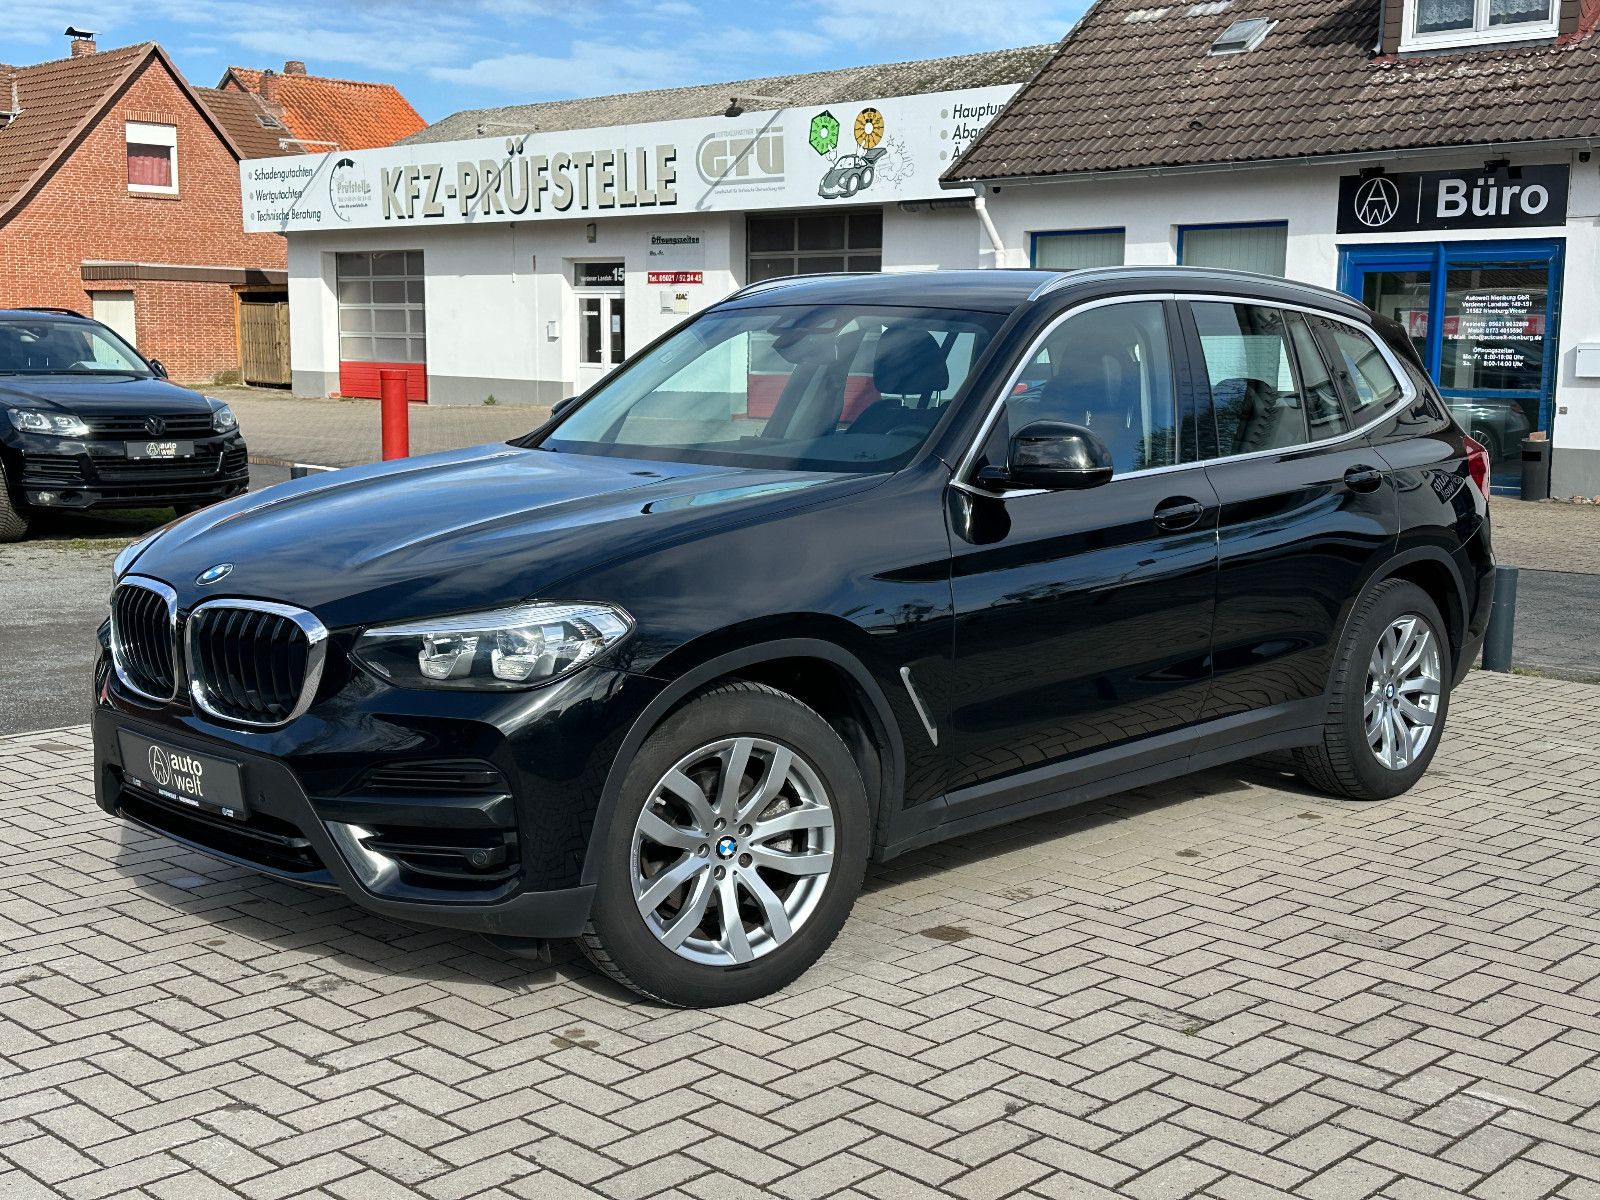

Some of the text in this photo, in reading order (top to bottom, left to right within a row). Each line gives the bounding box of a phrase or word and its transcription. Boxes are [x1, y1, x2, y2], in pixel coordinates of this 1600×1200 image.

[254, 166, 314, 182] Schadengutachten
[380, 136, 678, 220] KFZ-PRÜFSTELLE
[255, 188, 303, 202] Wertgutachten
[1436, 177, 1549, 218] Büro
[256, 209, 322, 222] Technische Beratung
[648, 274, 659, 282] Tel.
[171, 753, 203, 776] auto
[174, 773, 204, 797] welt
